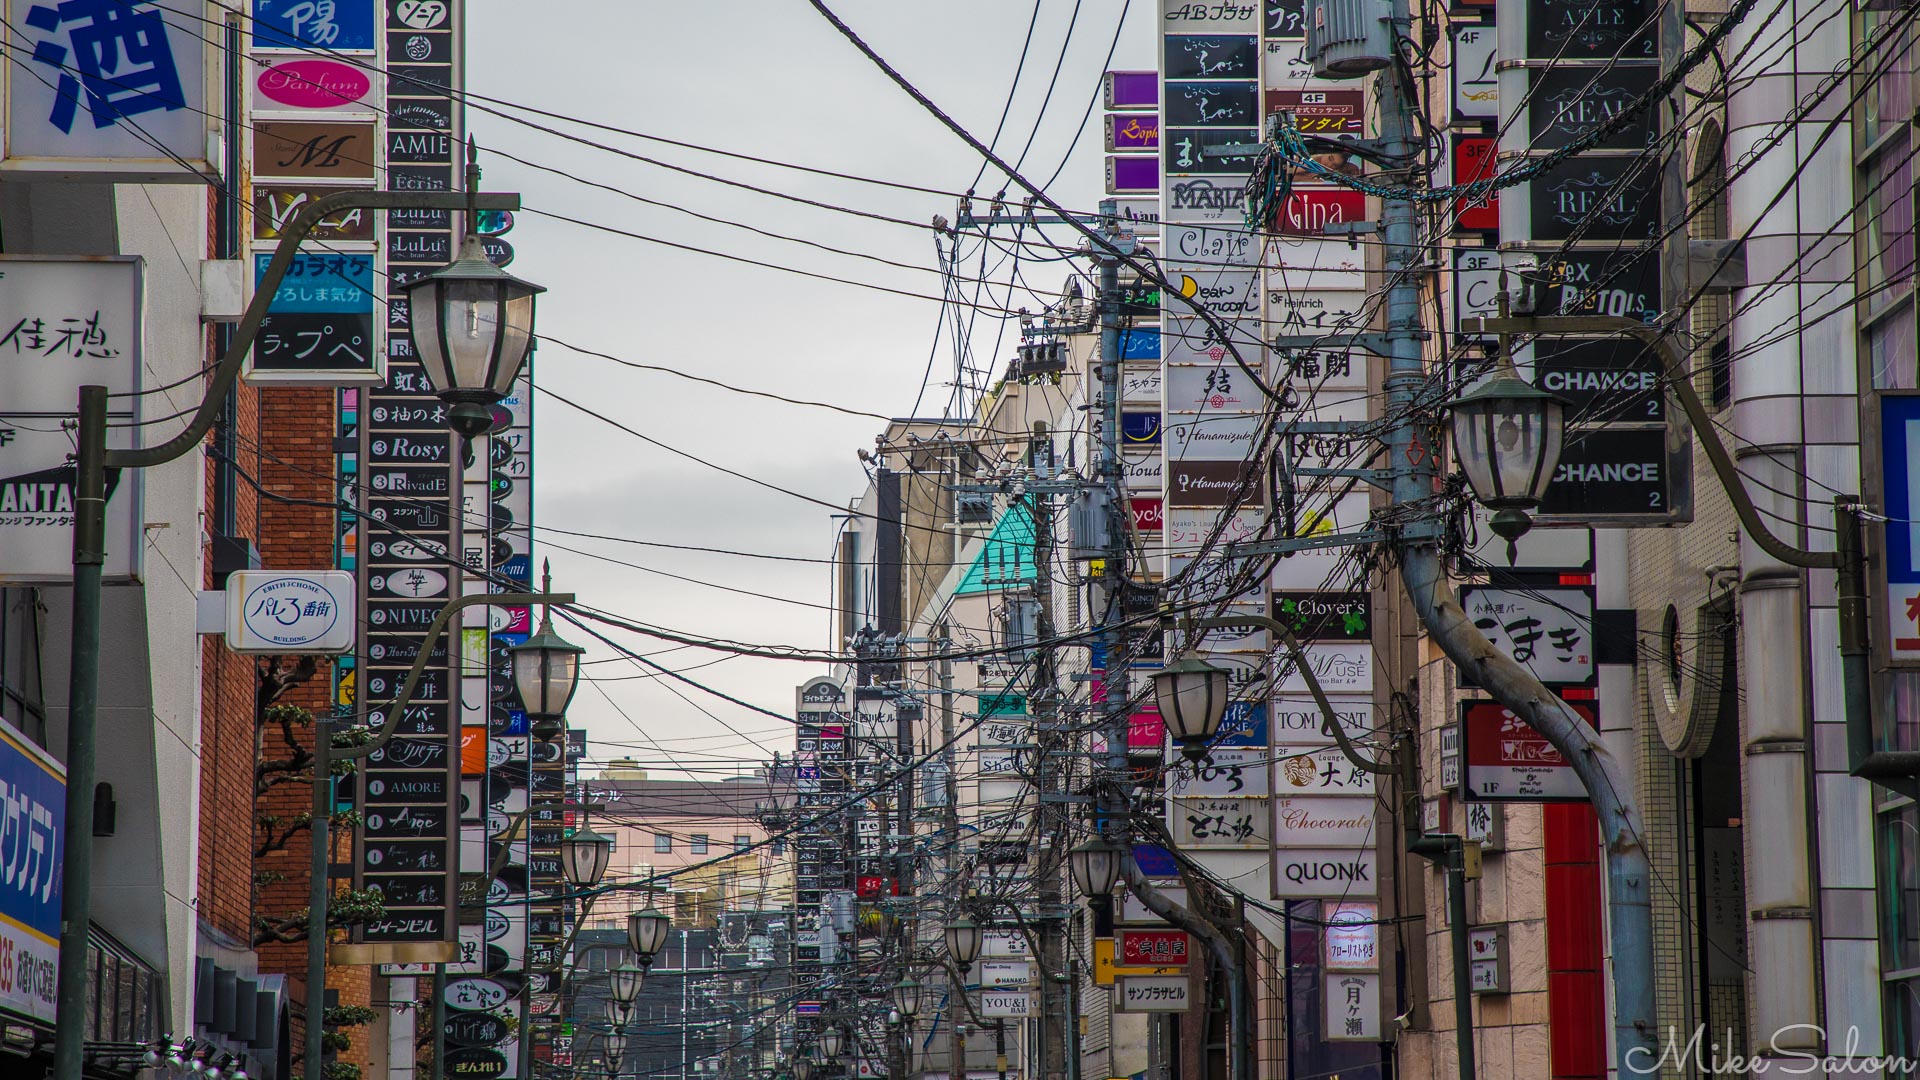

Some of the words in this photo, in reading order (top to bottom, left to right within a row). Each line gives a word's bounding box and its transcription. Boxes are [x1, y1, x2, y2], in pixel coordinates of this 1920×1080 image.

[1459, 31, 1480, 44] 4F
[1268, 42, 1281, 54] 4F
[1643, 40, 1653, 54] 2
[25, 0, 186, 135] 酒
[263, 70, 359, 96] Parfum
[1303, 93, 1324, 103] 4F
[392, 135, 448, 154] AMIE
[1466, 144, 1487, 158] 3F
[256, 189, 268, 197] 3F
[1558, 190, 1636, 214] REAL
[1179, 228, 1249, 257] Clair
[287, 257, 368, 277] カラオケ
[1467, 257, 1489, 270] 3F
[1270, 293, 1284, 304] 3F
[1284, 298, 1324, 309] Heinrich
[1203, 368, 1232, 395] 結
[1544, 371, 1657, 392] CHANCE
[1647, 400, 1659, 415] 2
[391, 438, 445, 461] Rosy
[1649, 491, 1661, 507] 2
[1298, 600, 1366, 615] Clover's
[1473, 603, 1526, 615] 小料理バー
[859, 713, 895, 723] 西川ビル
[1277, 712, 1316, 730] TOM
[987, 725, 1017, 739] 北海道
[1278, 748, 1289, 756] 2F
[1319, 761, 1370, 788] 大原
[391, 782, 441, 793] AMORE
[1482, 782, 1500, 794] 1F
[1281, 808, 1371, 830] Chocorate
[1285, 863, 1369, 884] QUONK
[1128, 986, 1186, 1000] サンプラザビル
[985, 998, 1026, 1008] YOU&I
[456, 1061, 502, 1073] ぎんれい
